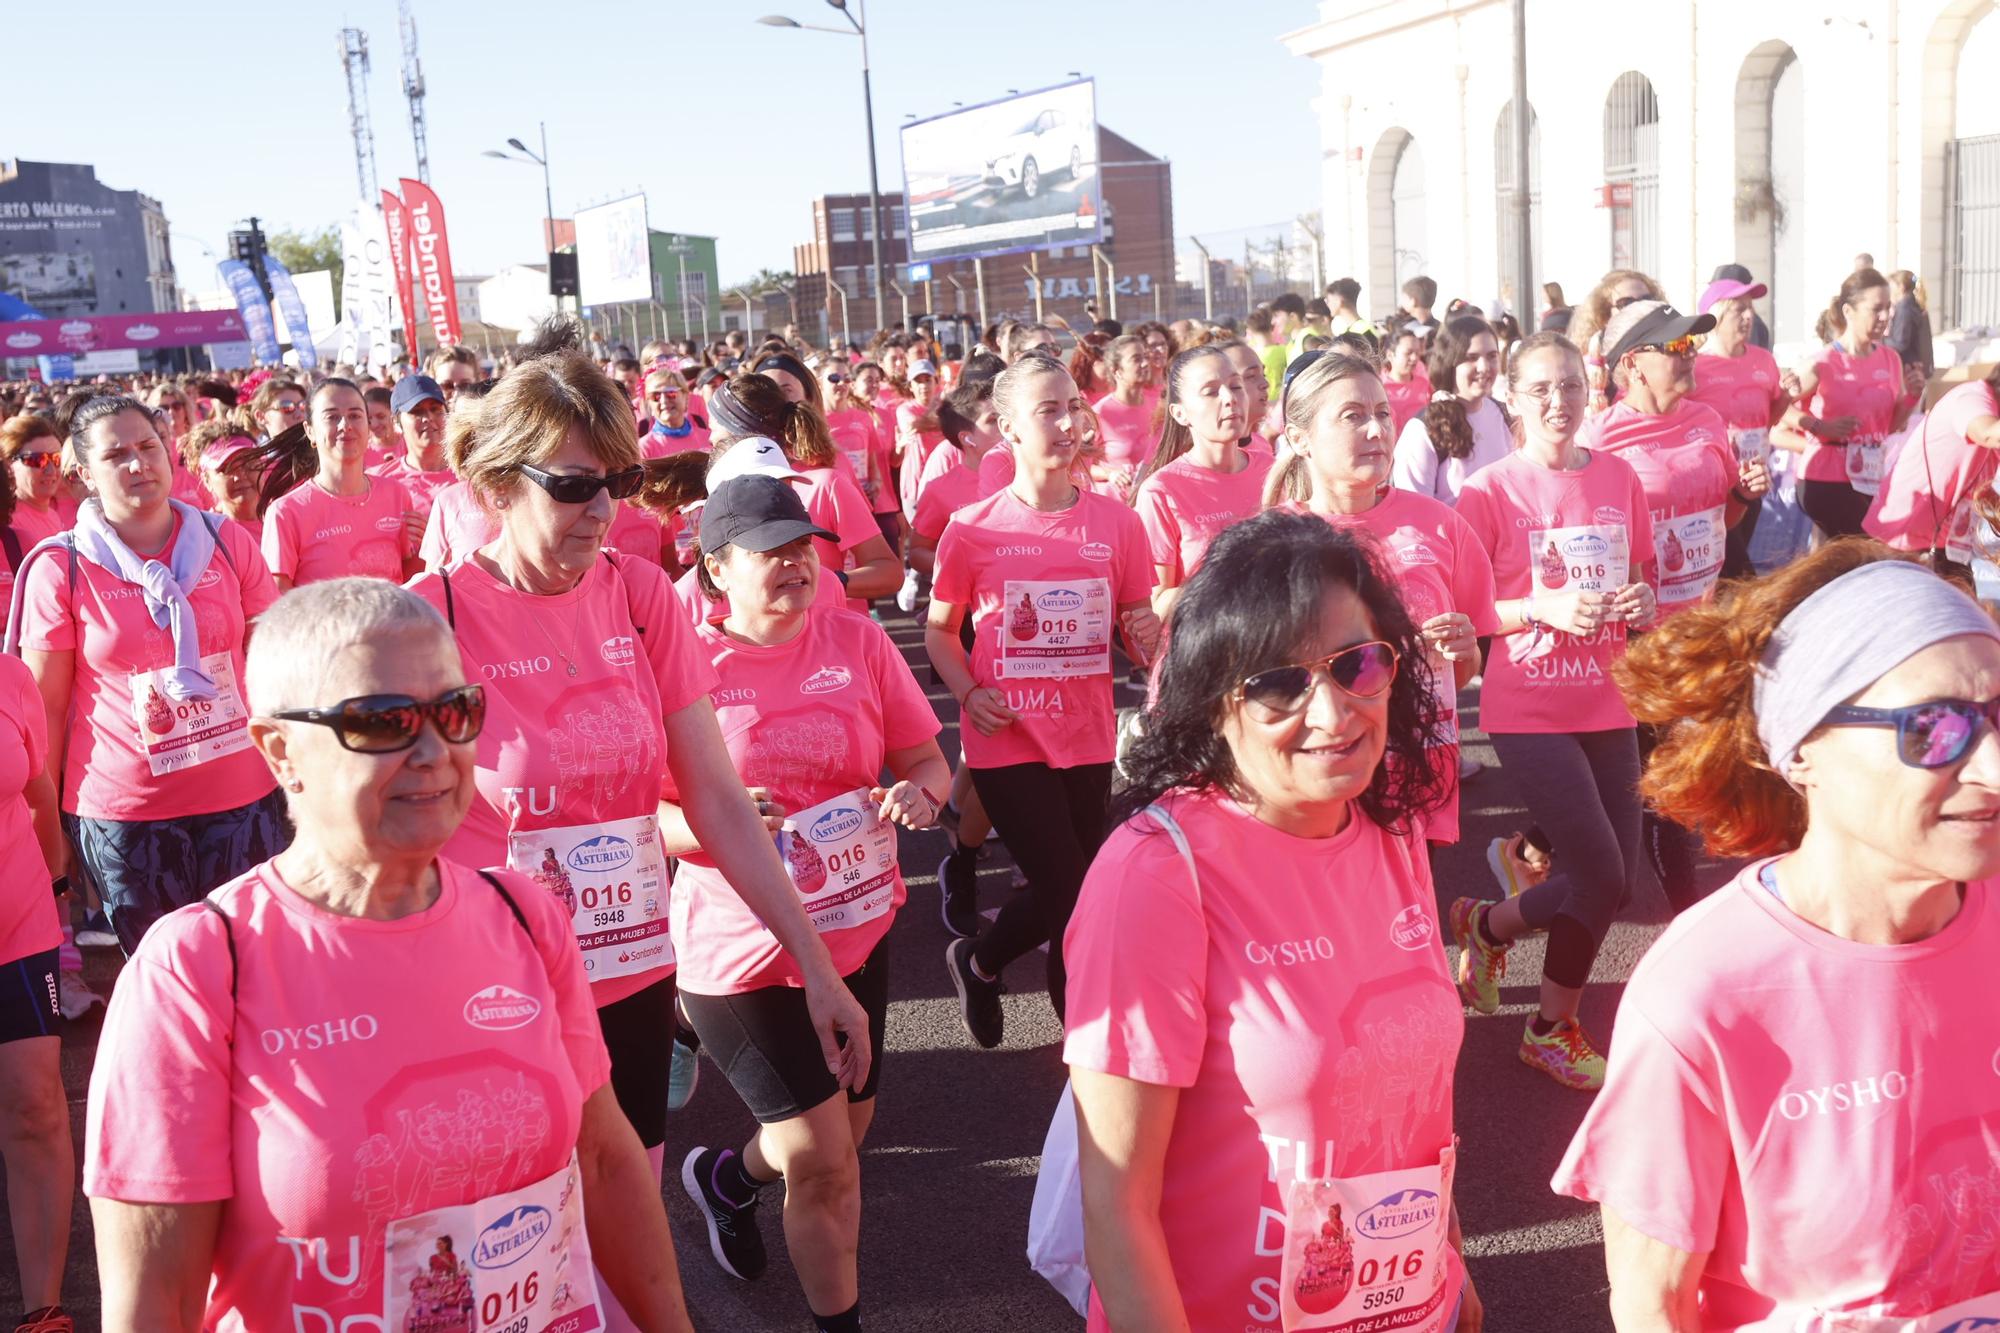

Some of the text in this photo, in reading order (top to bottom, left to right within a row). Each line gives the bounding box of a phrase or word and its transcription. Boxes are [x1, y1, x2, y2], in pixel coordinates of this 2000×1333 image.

[316, 524, 352, 539] OYSHO
[995, 545, 1042, 557] OYSHO
[1686, 543, 1710, 560] 016
[1571, 564, 1606, 579] 016
[1579, 581, 1601, 591] 4424
[1041, 599, 1080, 607] ASTURIANA
[1042, 619, 1078, 633] 016
[1047, 636, 1070, 645] 4427
[481, 656, 550, 680] OYSHO
[1013, 662, 1046, 671] OYSHO
[1525, 655, 1603, 679] SUMA
[710, 688, 757, 705] YSHO
[1007, 687, 1064, 711] UMA
[176, 701, 212, 719] 016
[188, 716, 210, 730] 5997
[159, 736, 192, 750] CARRERA
[161, 750, 197, 766] OYSHO
[501, 785, 558, 816] TU
[815, 817, 860, 840] ASTURIANA
[574, 849, 631, 866] ASTURIANA
[827, 843, 865, 873] 016
[843, 868, 861, 885] 546
[581, 881, 632, 909] 016
[806, 895, 843, 911] CARRERA
[843, 890, 854, 901] DE
[853, 887, 862, 897] LA
[594, 909, 625, 927] 5948
[813, 910, 845, 927] YSHO
[595, 936, 605, 945] DE
[607, 933, 619, 942] LA
[621, 928, 646, 940] MUJER
[647, 923, 661, 934] 2023
[631, 944, 664, 962] Santander
[472, 1003, 536, 1021] ASTURIANA
[261, 1014, 378, 1055] OYSHO
[1779, 1071, 1906, 1121] OYSHO
[1363, 1206, 1435, 1232] ASTURIANA
[478, 1220, 545, 1262] ASTURIANA
[276, 1235, 360, 1286] TU
[1358, 1249, 1424, 1287] 016
[482, 1271, 539, 1326] 016
[1362, 1286, 1405, 1310] 5950
[1356, 1319, 1373, 1333] DE
[1374, 1317, 1390, 1330] LA
[1391, 1305, 1428, 1327] MUJER
